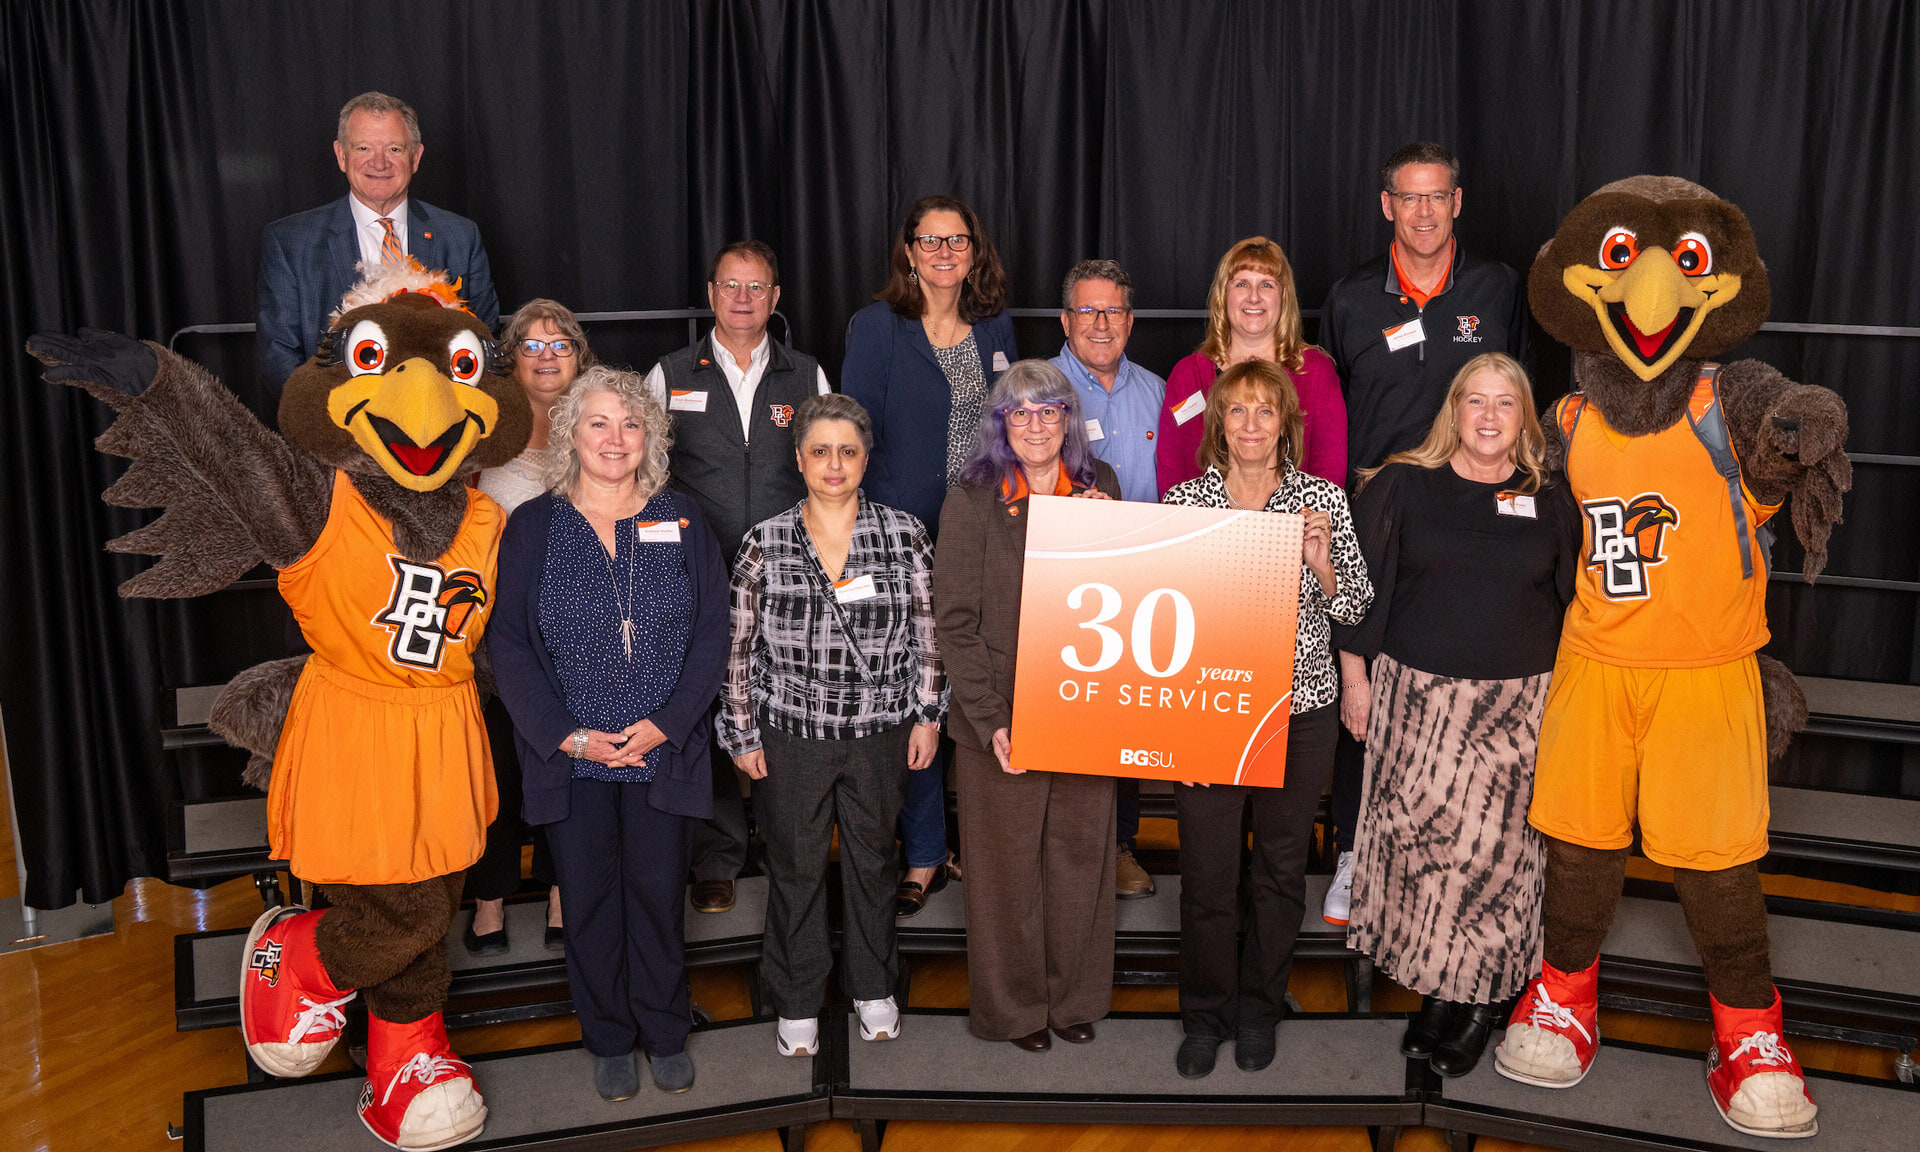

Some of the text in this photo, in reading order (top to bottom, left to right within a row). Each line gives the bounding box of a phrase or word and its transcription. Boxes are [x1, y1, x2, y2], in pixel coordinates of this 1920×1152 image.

[1583, 501, 1648, 598] BG
[376, 558, 448, 669] BG
[1060, 582, 1254, 685] 30 years
[1059, 680, 1252, 714] OF SERVICE
